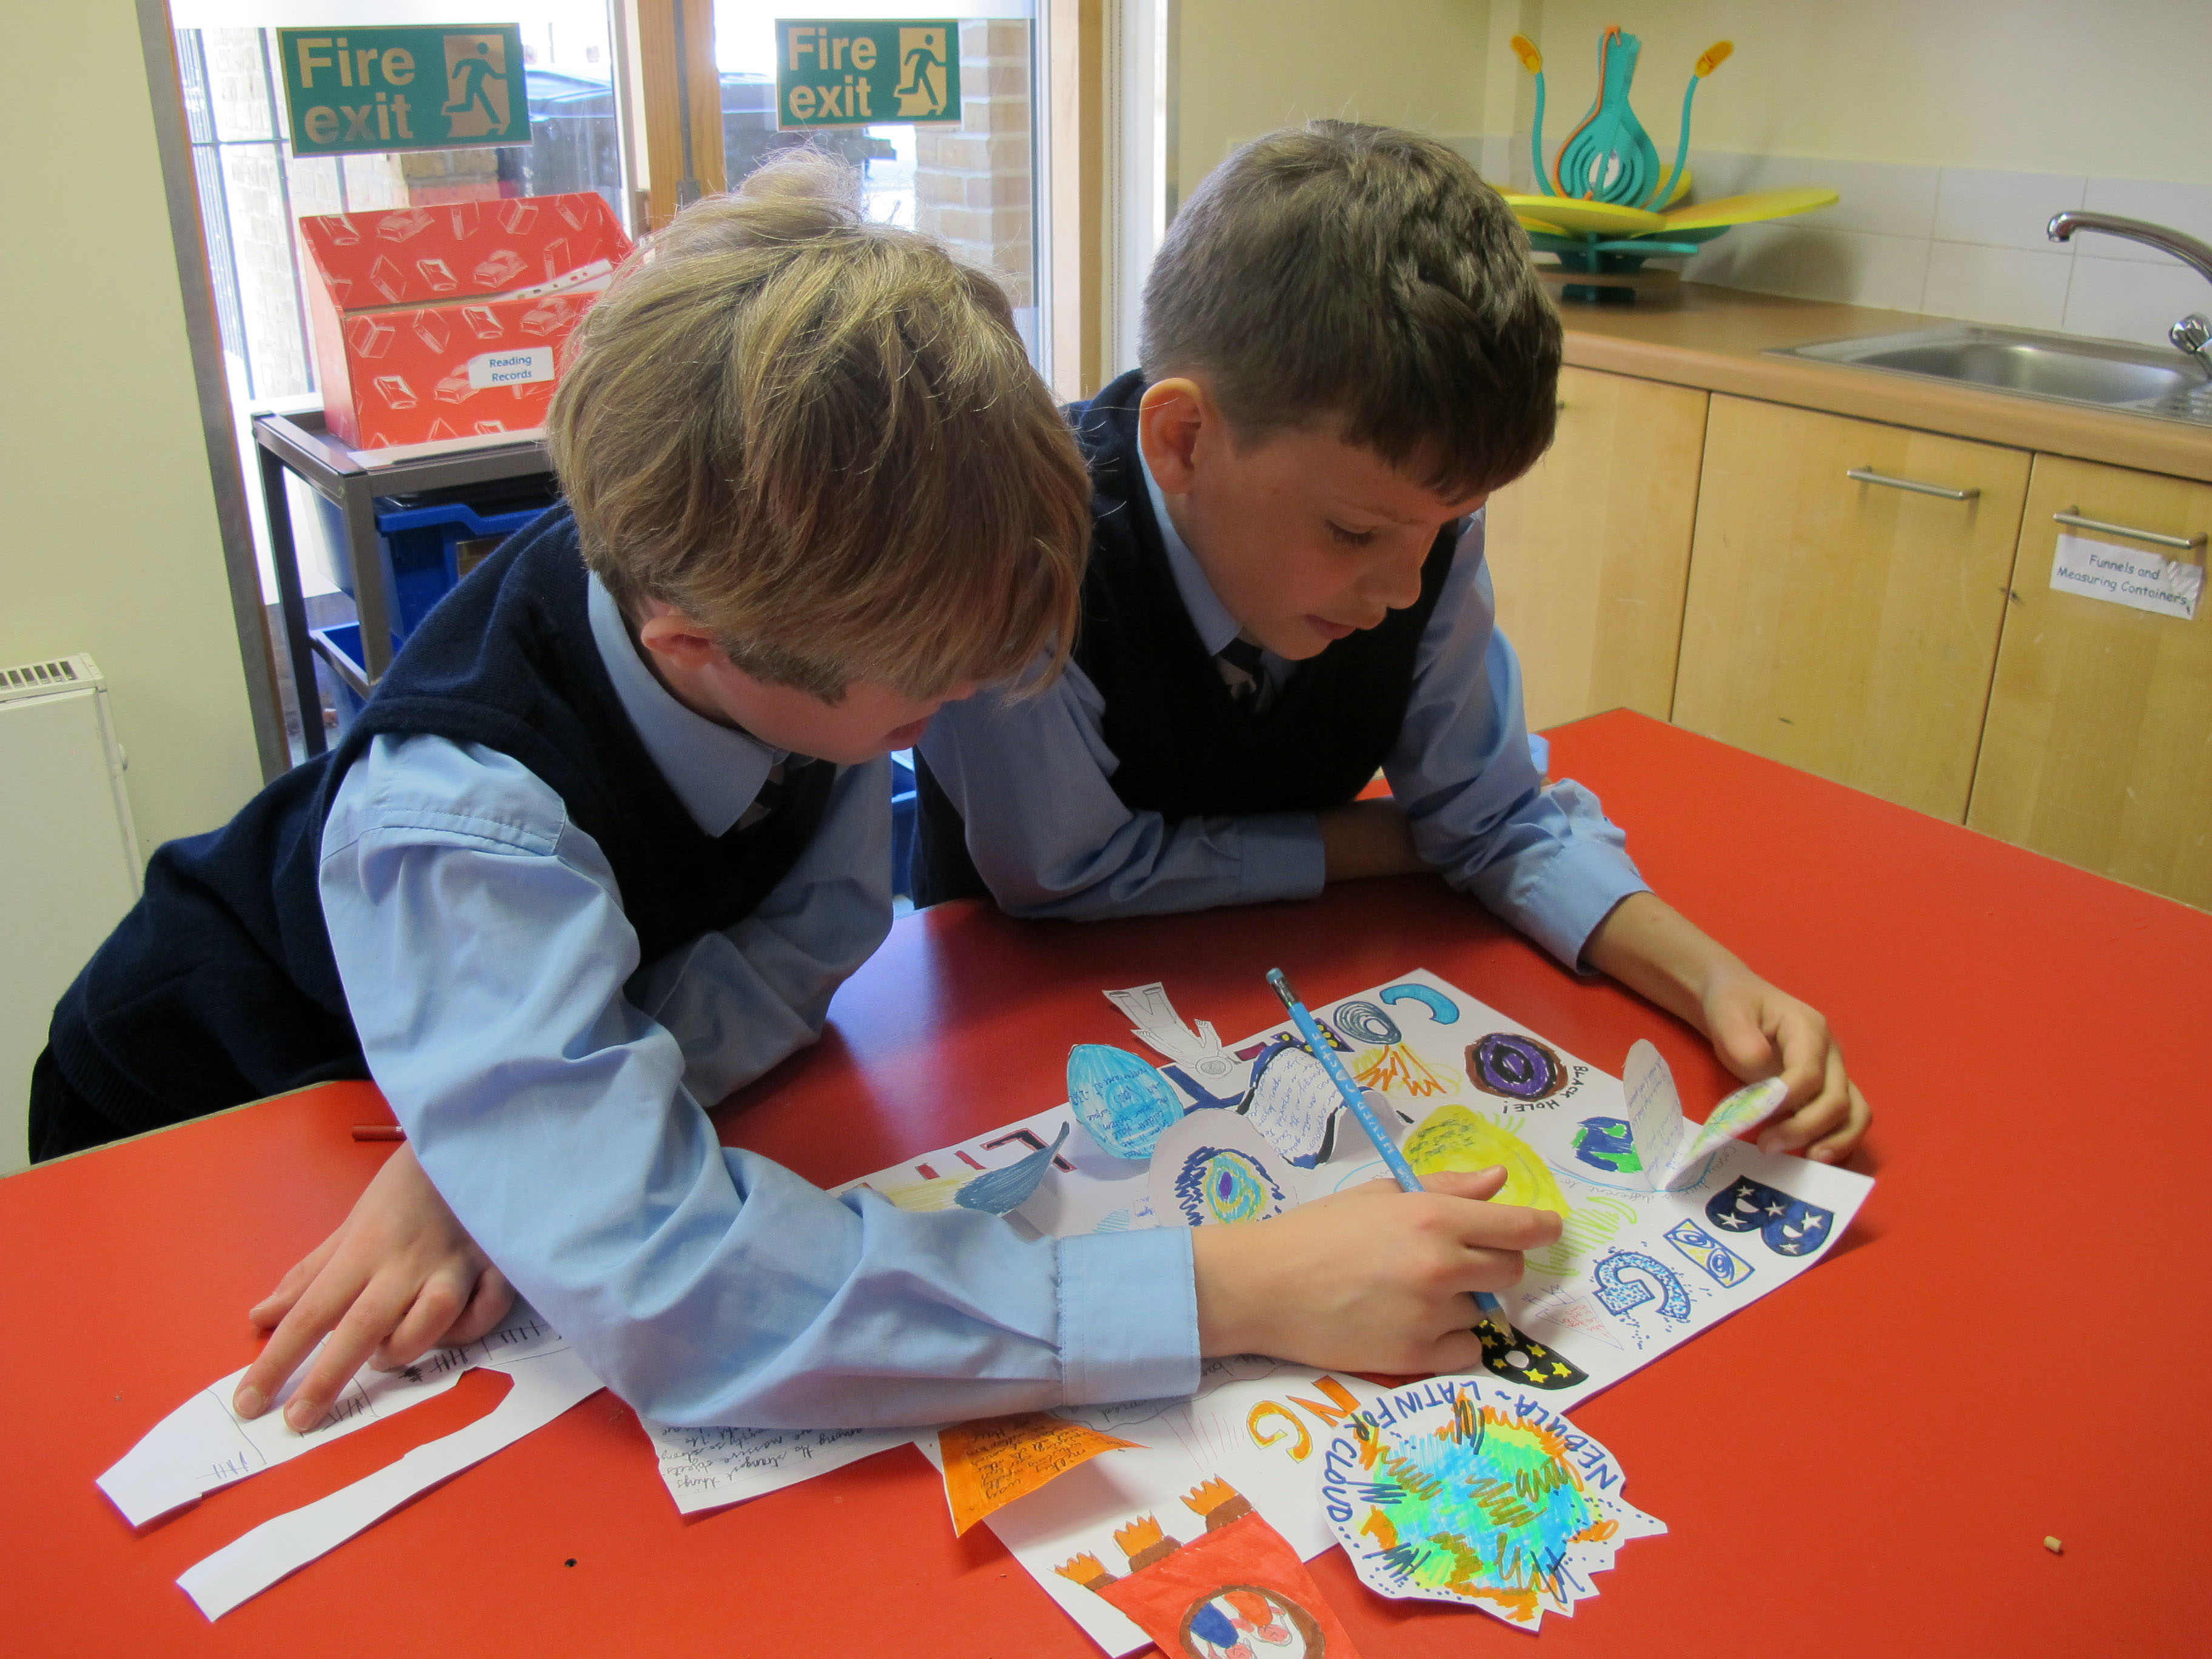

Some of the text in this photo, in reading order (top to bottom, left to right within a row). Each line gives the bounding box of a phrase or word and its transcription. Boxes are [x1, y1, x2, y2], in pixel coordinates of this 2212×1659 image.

[297, 38, 415, 88] Fire
[789, 27, 877, 70] Fire
[789, 75, 873, 119] exit
[304, 92, 414, 144] exit
[489, 357, 532, 367] Reading
[492, 370, 532, 382] Records
[2057, 567, 2187, 605] Measuring Containers
[2088, 554, 2160, 580] Funnels and
[1560, 1066, 1589, 1099] BLACK
[1322, 1381, 1620, 1523] NEBULA LATIN FOR CLOUD
